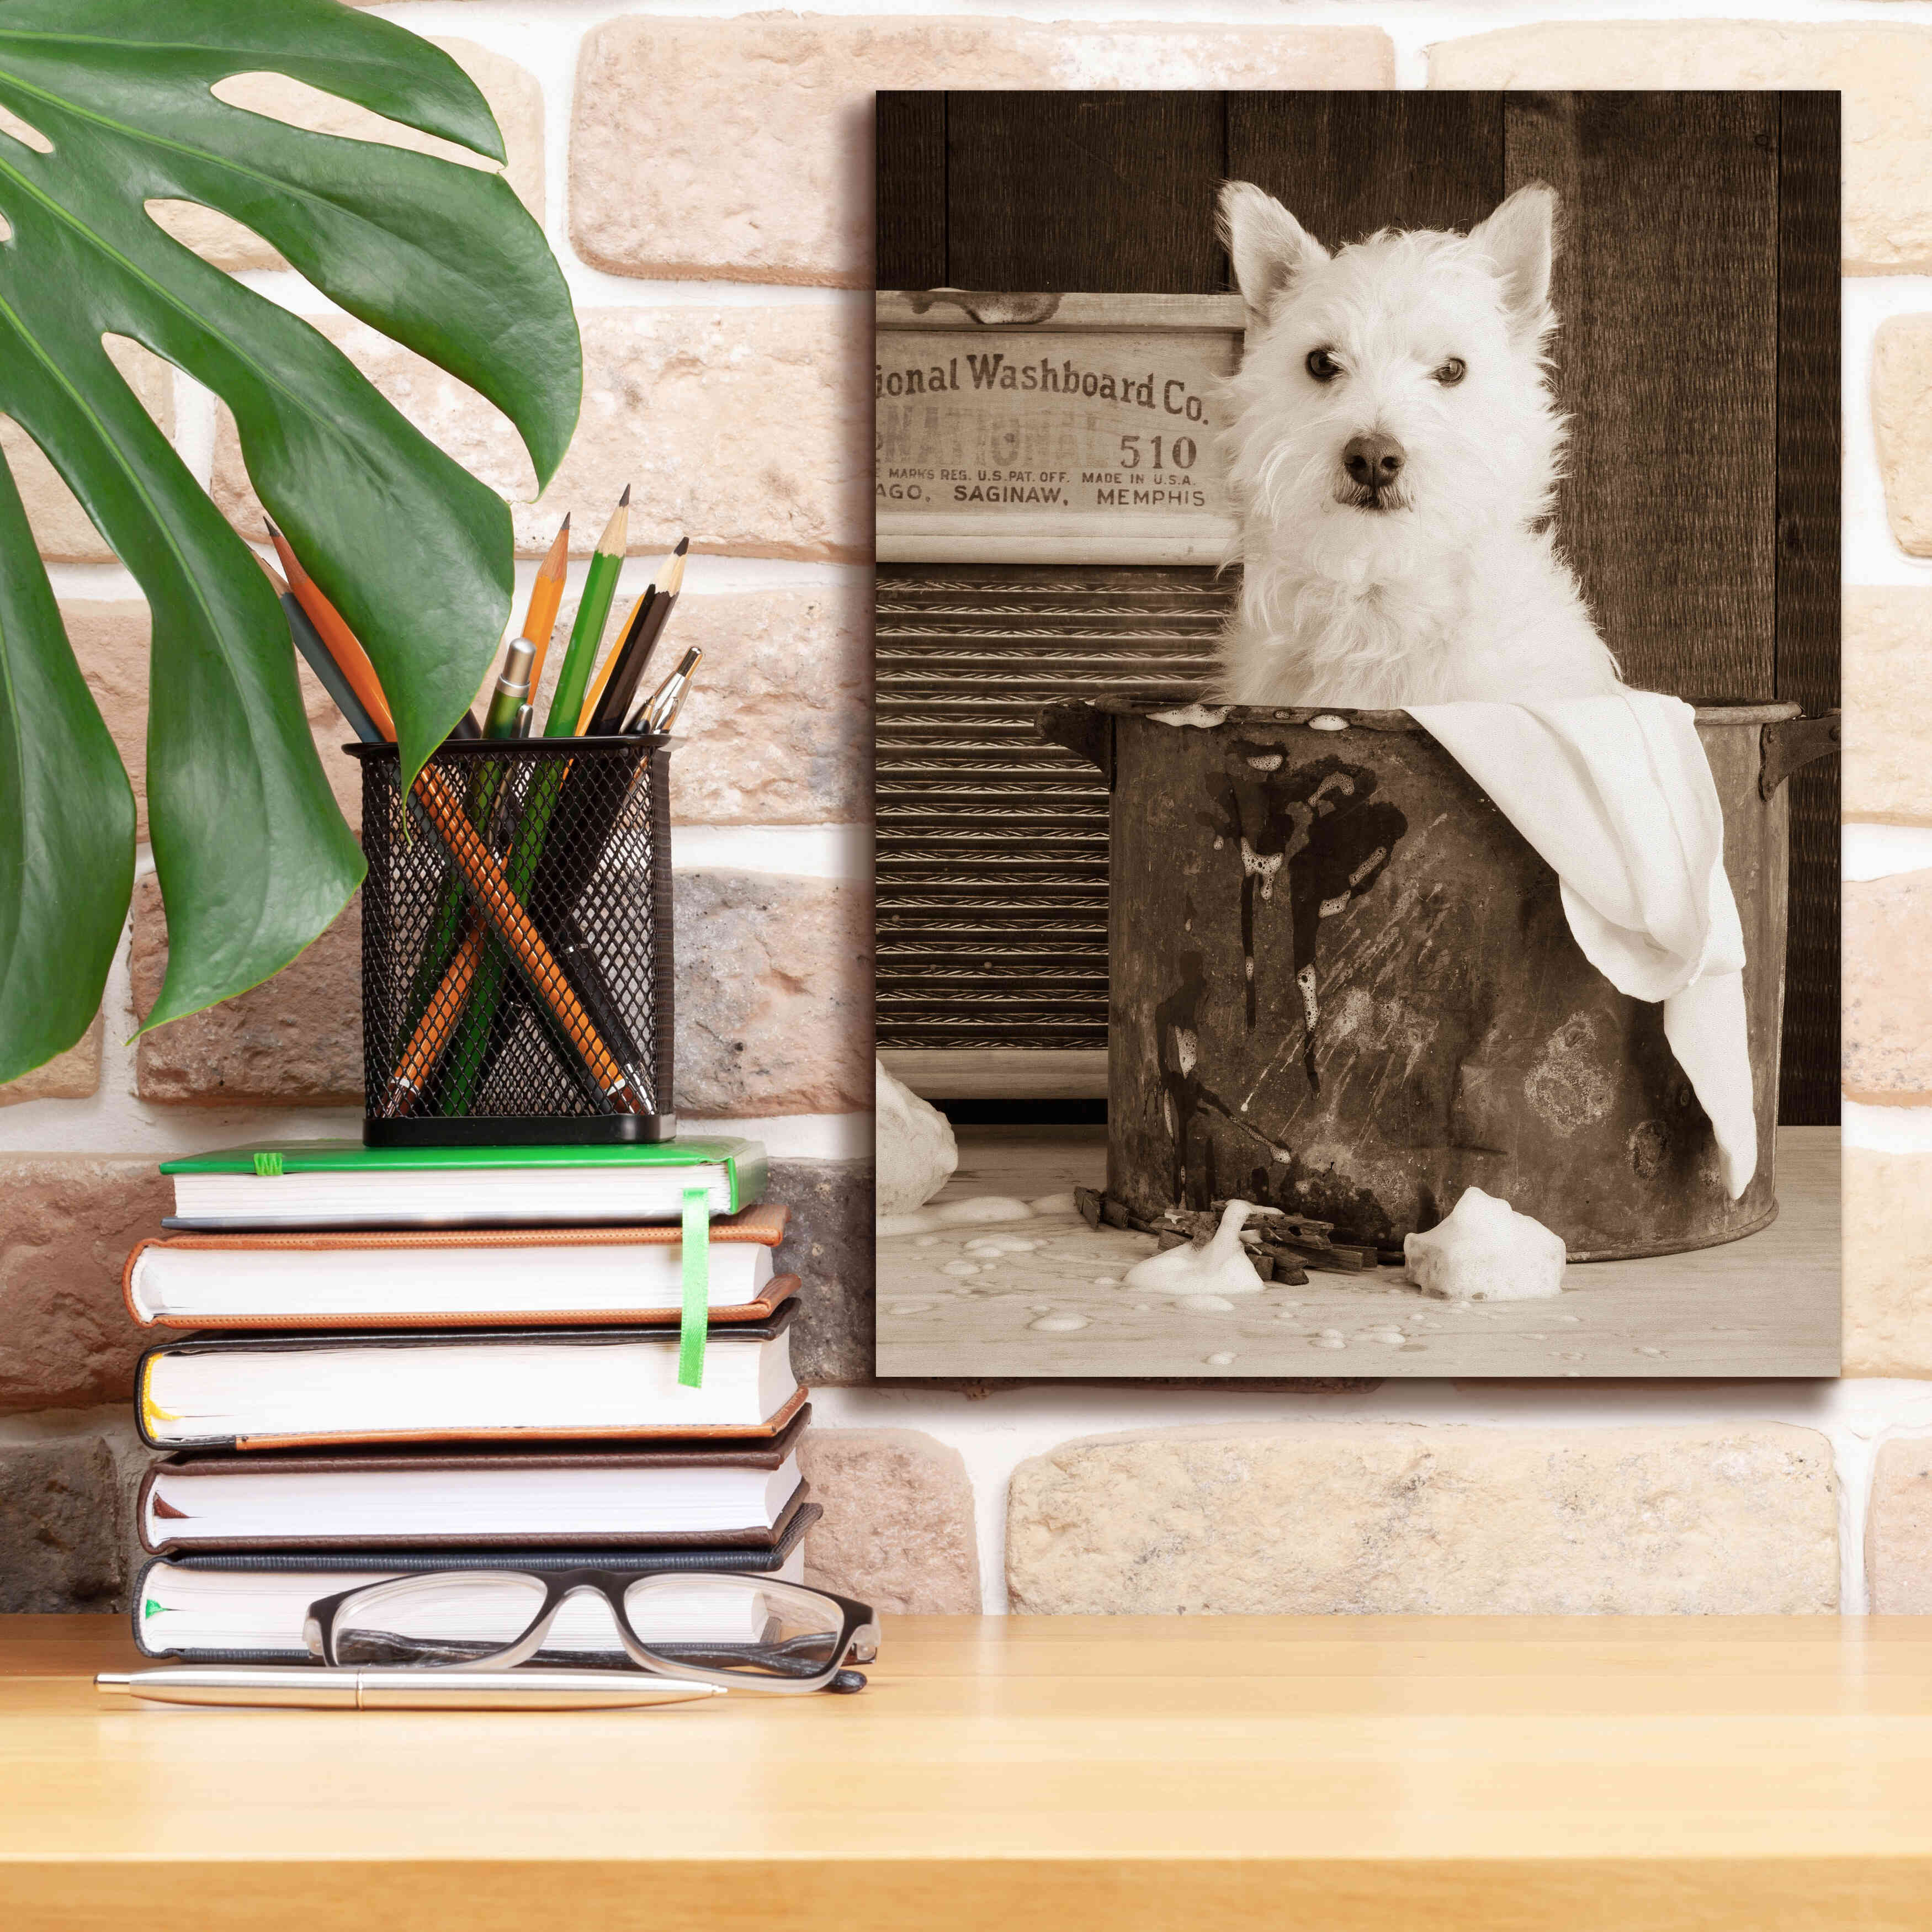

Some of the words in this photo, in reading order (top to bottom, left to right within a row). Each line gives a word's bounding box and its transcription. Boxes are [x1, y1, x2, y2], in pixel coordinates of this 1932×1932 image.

[967, 353, 1156, 410] Washboard
[1163, 379, 1209, 426] Co.
[1120, 434, 1197, 469] 510
[940, 469, 972, 481] REG.
[1039, 471, 1070, 483] OFF.
[1081, 471, 1122, 484] MADE
[1130, 473, 1144, 484] IN
[1154, 474, 1196, 486] U.S.A.
[1096, 488, 1206, 507] MEMPHIS
